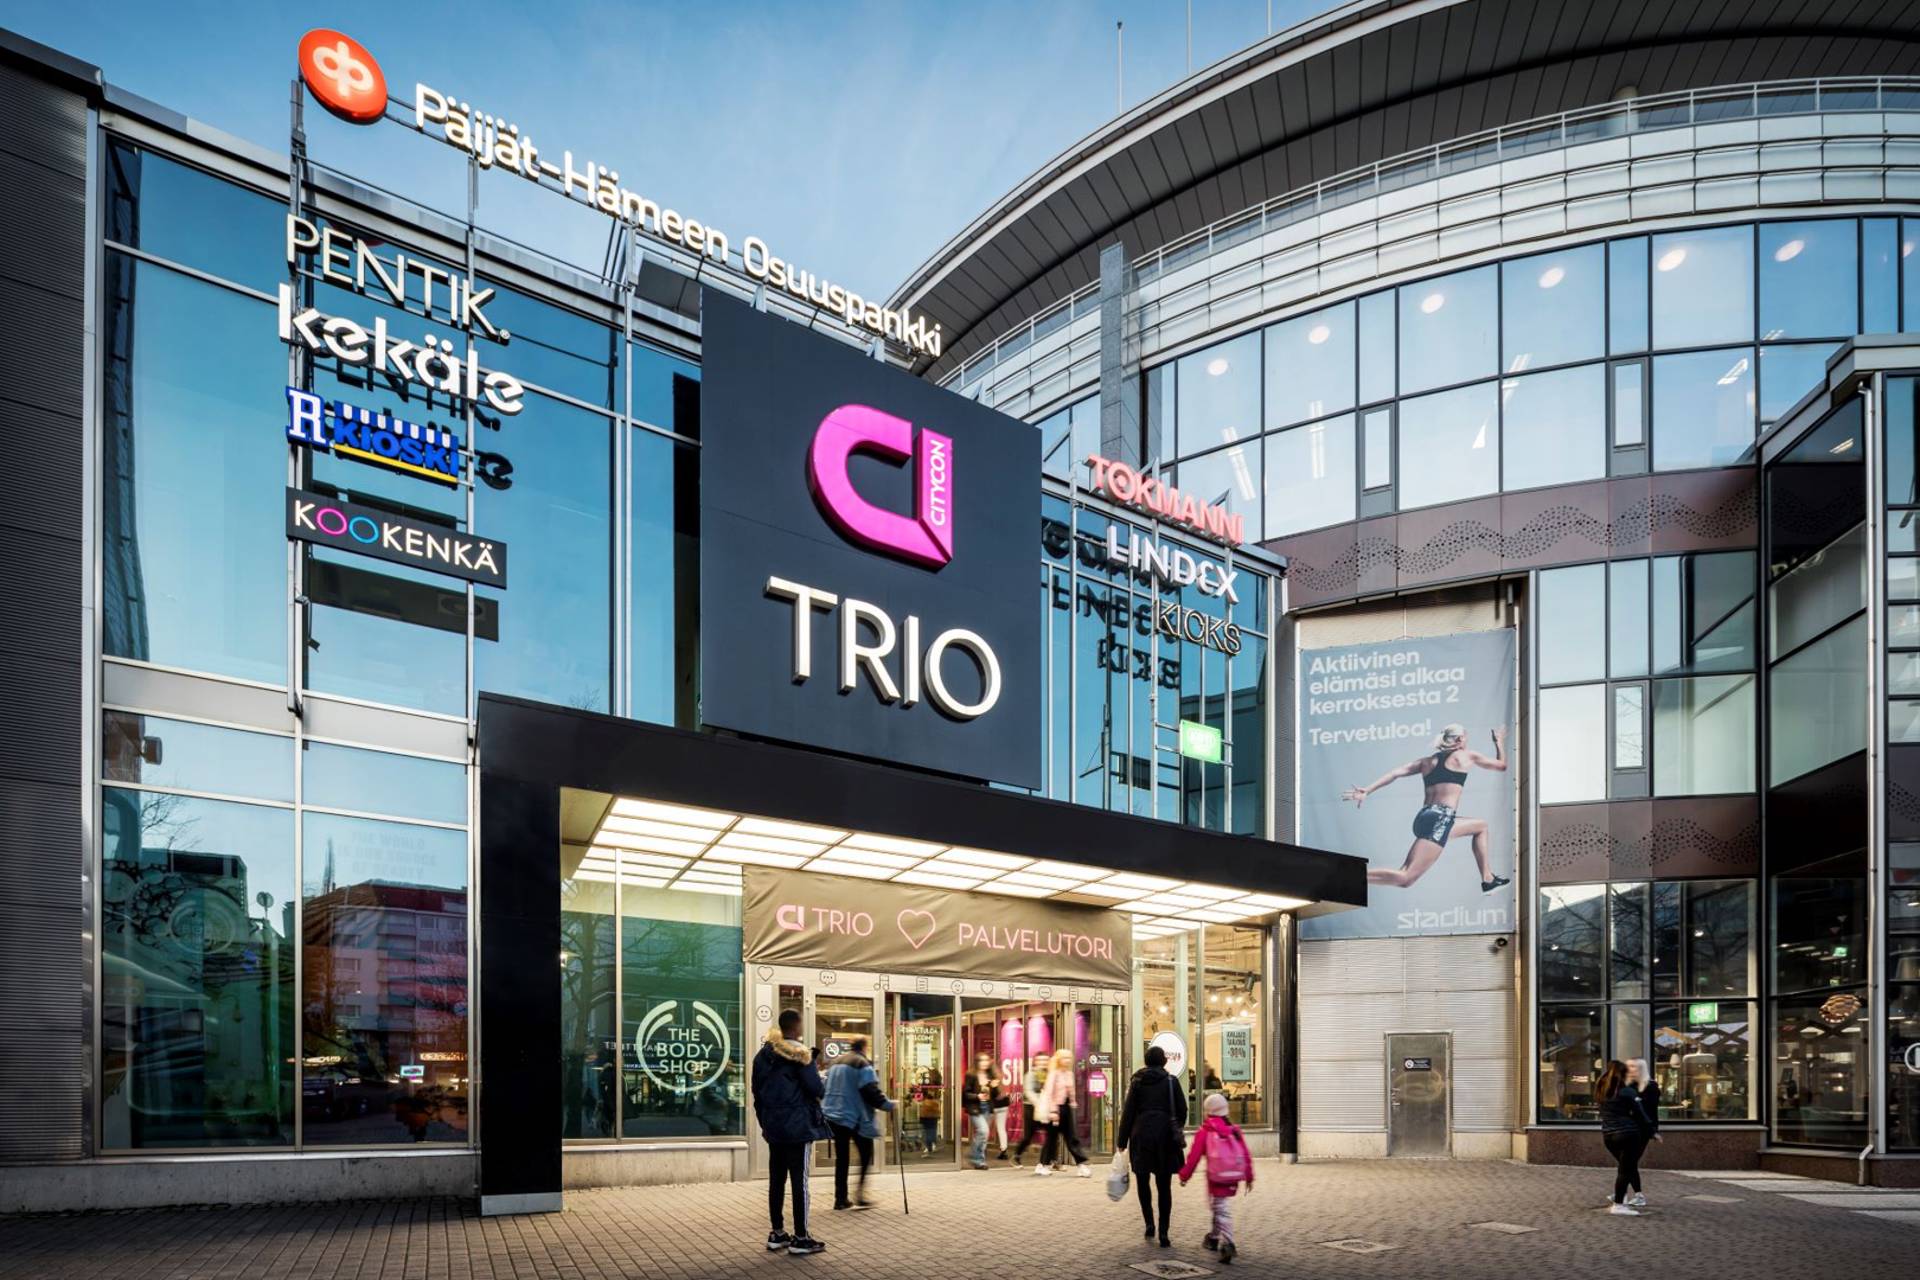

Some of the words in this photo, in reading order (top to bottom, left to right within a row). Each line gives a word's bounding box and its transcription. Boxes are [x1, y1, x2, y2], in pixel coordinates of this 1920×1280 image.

[414, 82, 729, 263] Päijät-Hämeen
[742, 235, 942, 358] Osuuspankki
[278, 282, 525, 417] kekäle
[333, 416, 459, 477] KIOSKI
[930, 439, 947, 527] CITYCON
[1085, 453, 1245, 546] TOKMANNI
[294, 499, 500, 576] KOOKENKÄ
[1106, 524, 1240, 605] LINDEX
[763, 575, 1002, 720] TRIO
[1153, 598, 1242, 655] KICKS
[1308, 651, 1420, 676] Aktiivinen
[1309, 670, 1397, 696] elämäsi
[1401, 666, 1465, 687] alkaa
[1309, 689, 1442, 716] kerroksesta
[1445, 684, 1460, 704] 2
[1309, 718, 1433, 746] Tervetuloa!
[811, 906, 875, 938] TRIO
[958, 922, 1113, 961] PALVELUTORI
[1396, 905, 1508, 930] stadium
[656, 1041, 714, 1060] BODY
[667, 1027, 701, 1042] THE
[659, 1059, 711, 1075] SHOP
